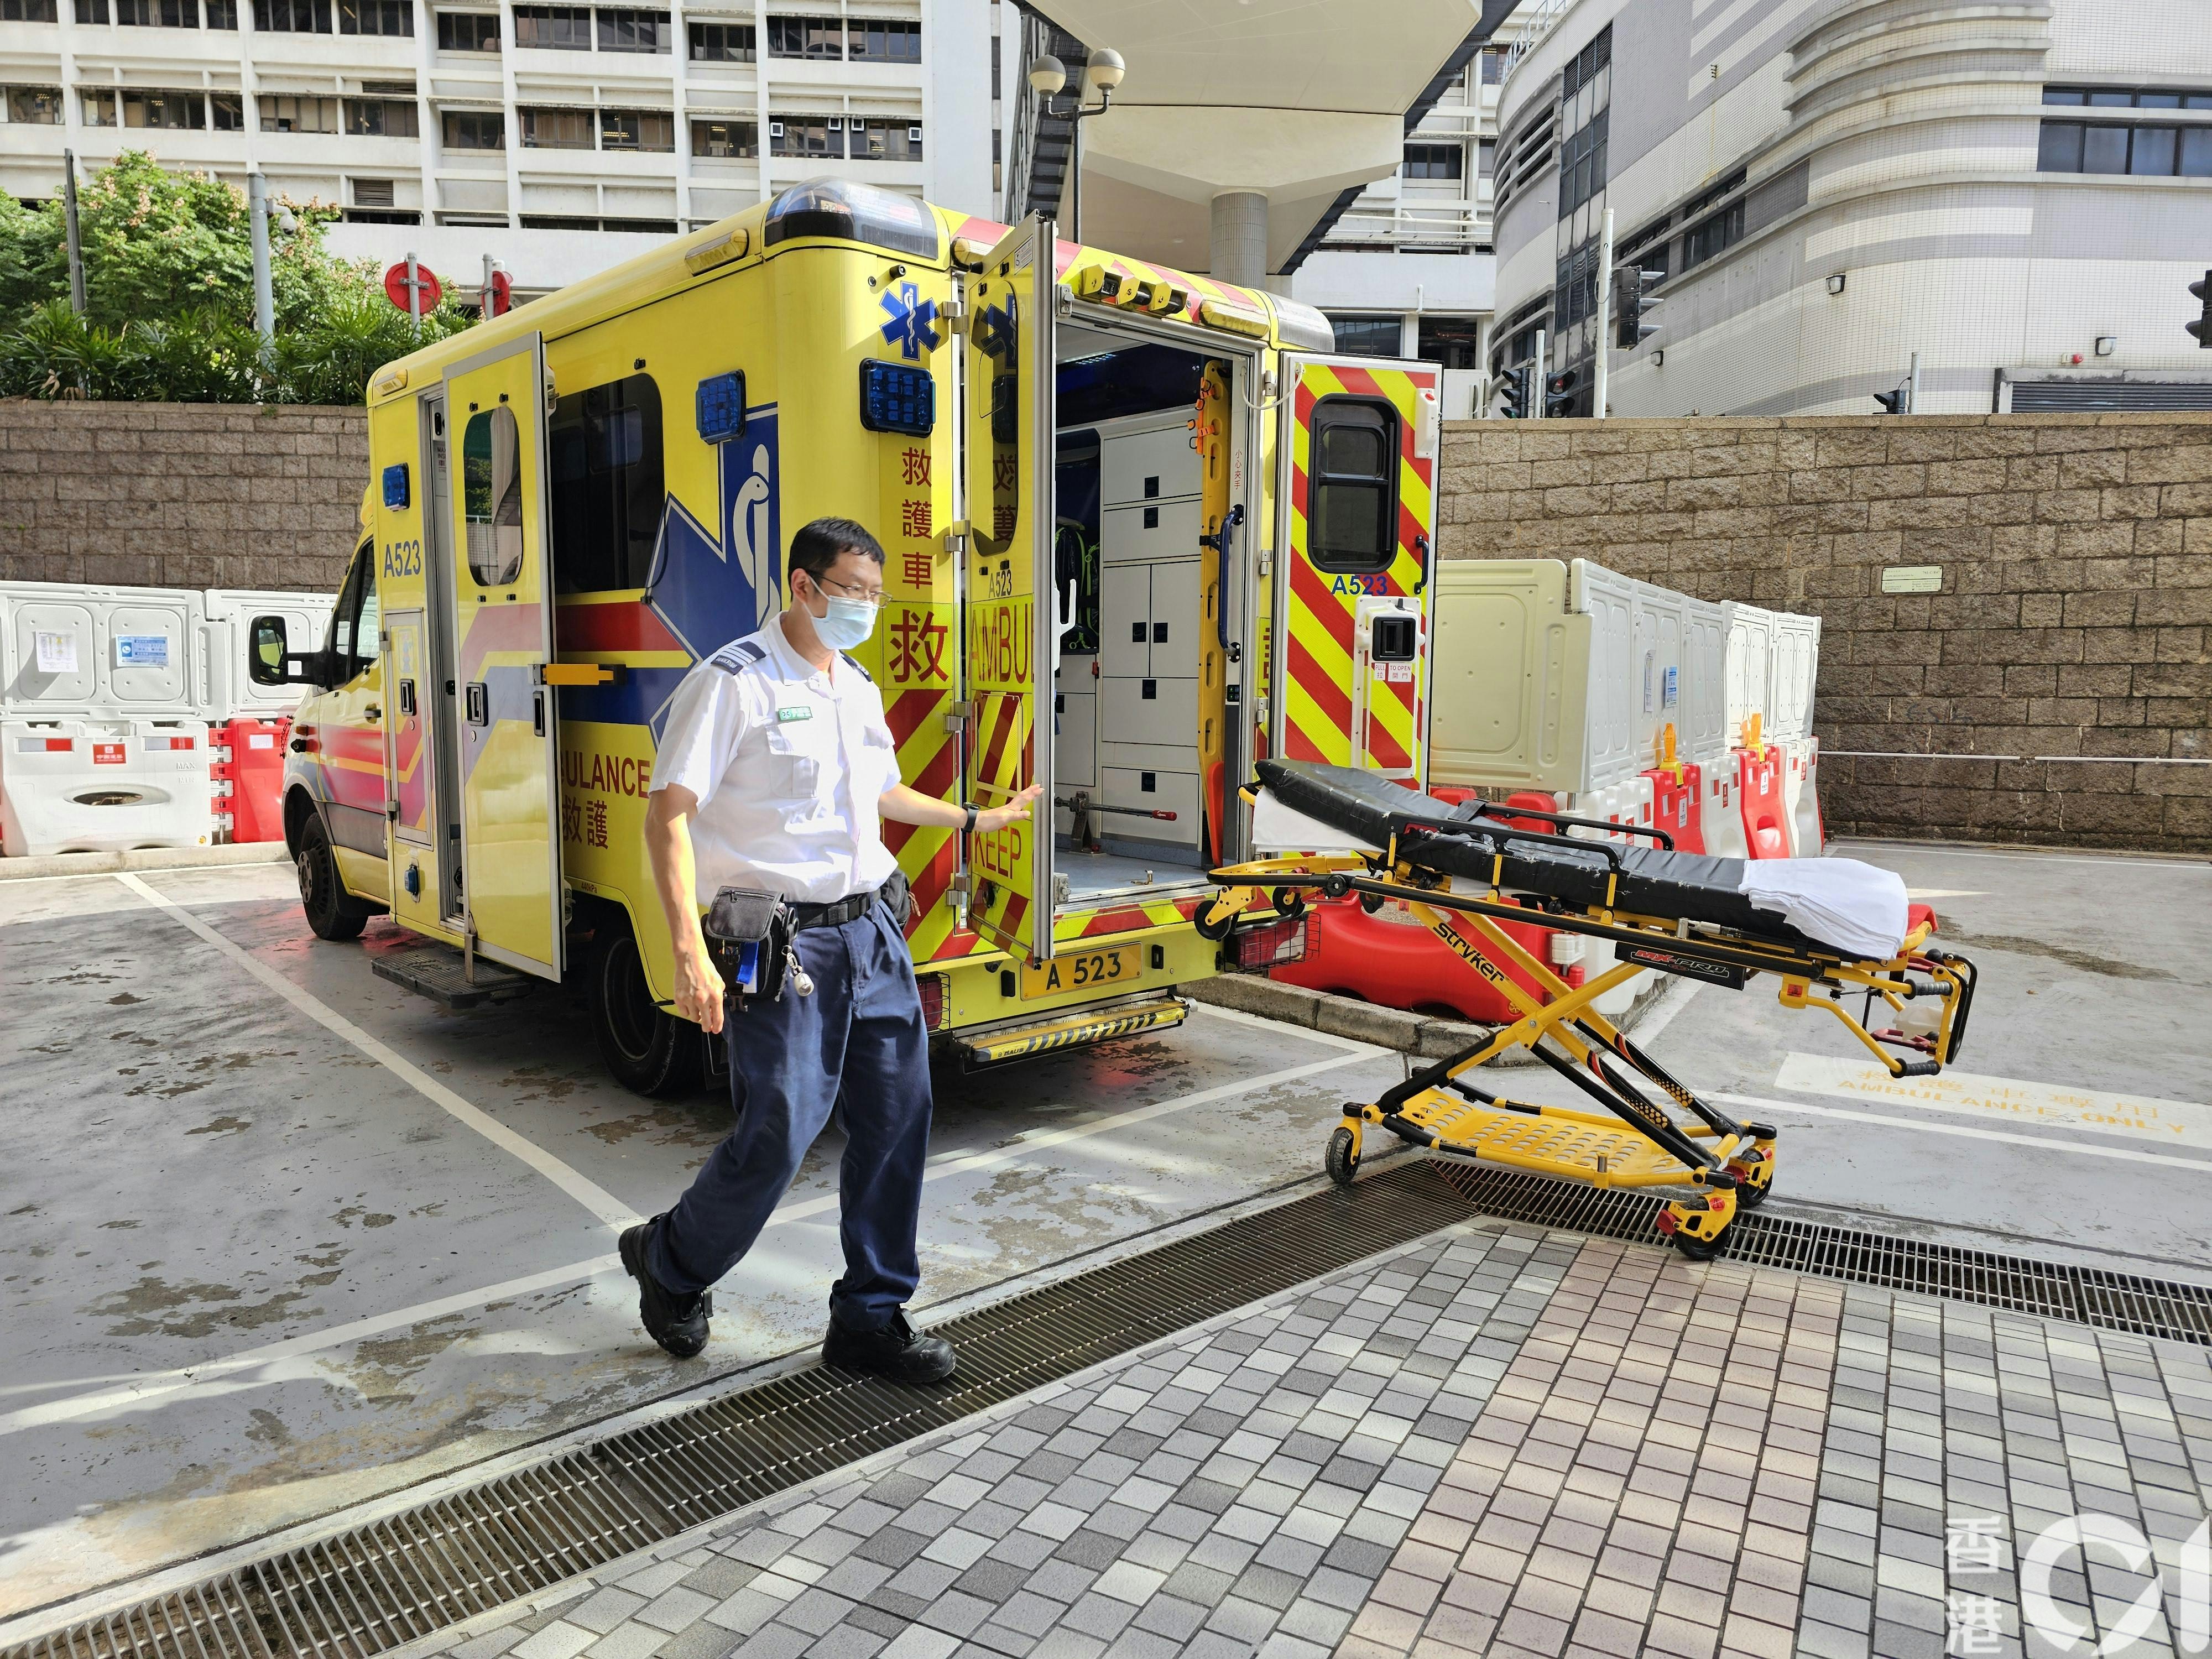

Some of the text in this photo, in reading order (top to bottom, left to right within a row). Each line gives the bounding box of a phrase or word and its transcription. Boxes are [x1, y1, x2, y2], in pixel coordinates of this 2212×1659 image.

[1234, 449, 1243, 490] 小心夾手
[902, 447, 932, 589] 救護車
[384, 539, 421, 578] A523
[989, 569, 1012, 598] A523
[1331, 575, 1387, 595] A523
[889, 609, 949, 682] 救
[176, 761, 196, 770] MAX
[561, 794, 608, 850] 救護
[975, 826, 1022, 880] KEEP
[1046, 952, 1121, 990] A 523
[1635, 950, 1729, 973] MX-PRO
[1837, 1079, 2185, 1134] AMBULANCE ONLY
